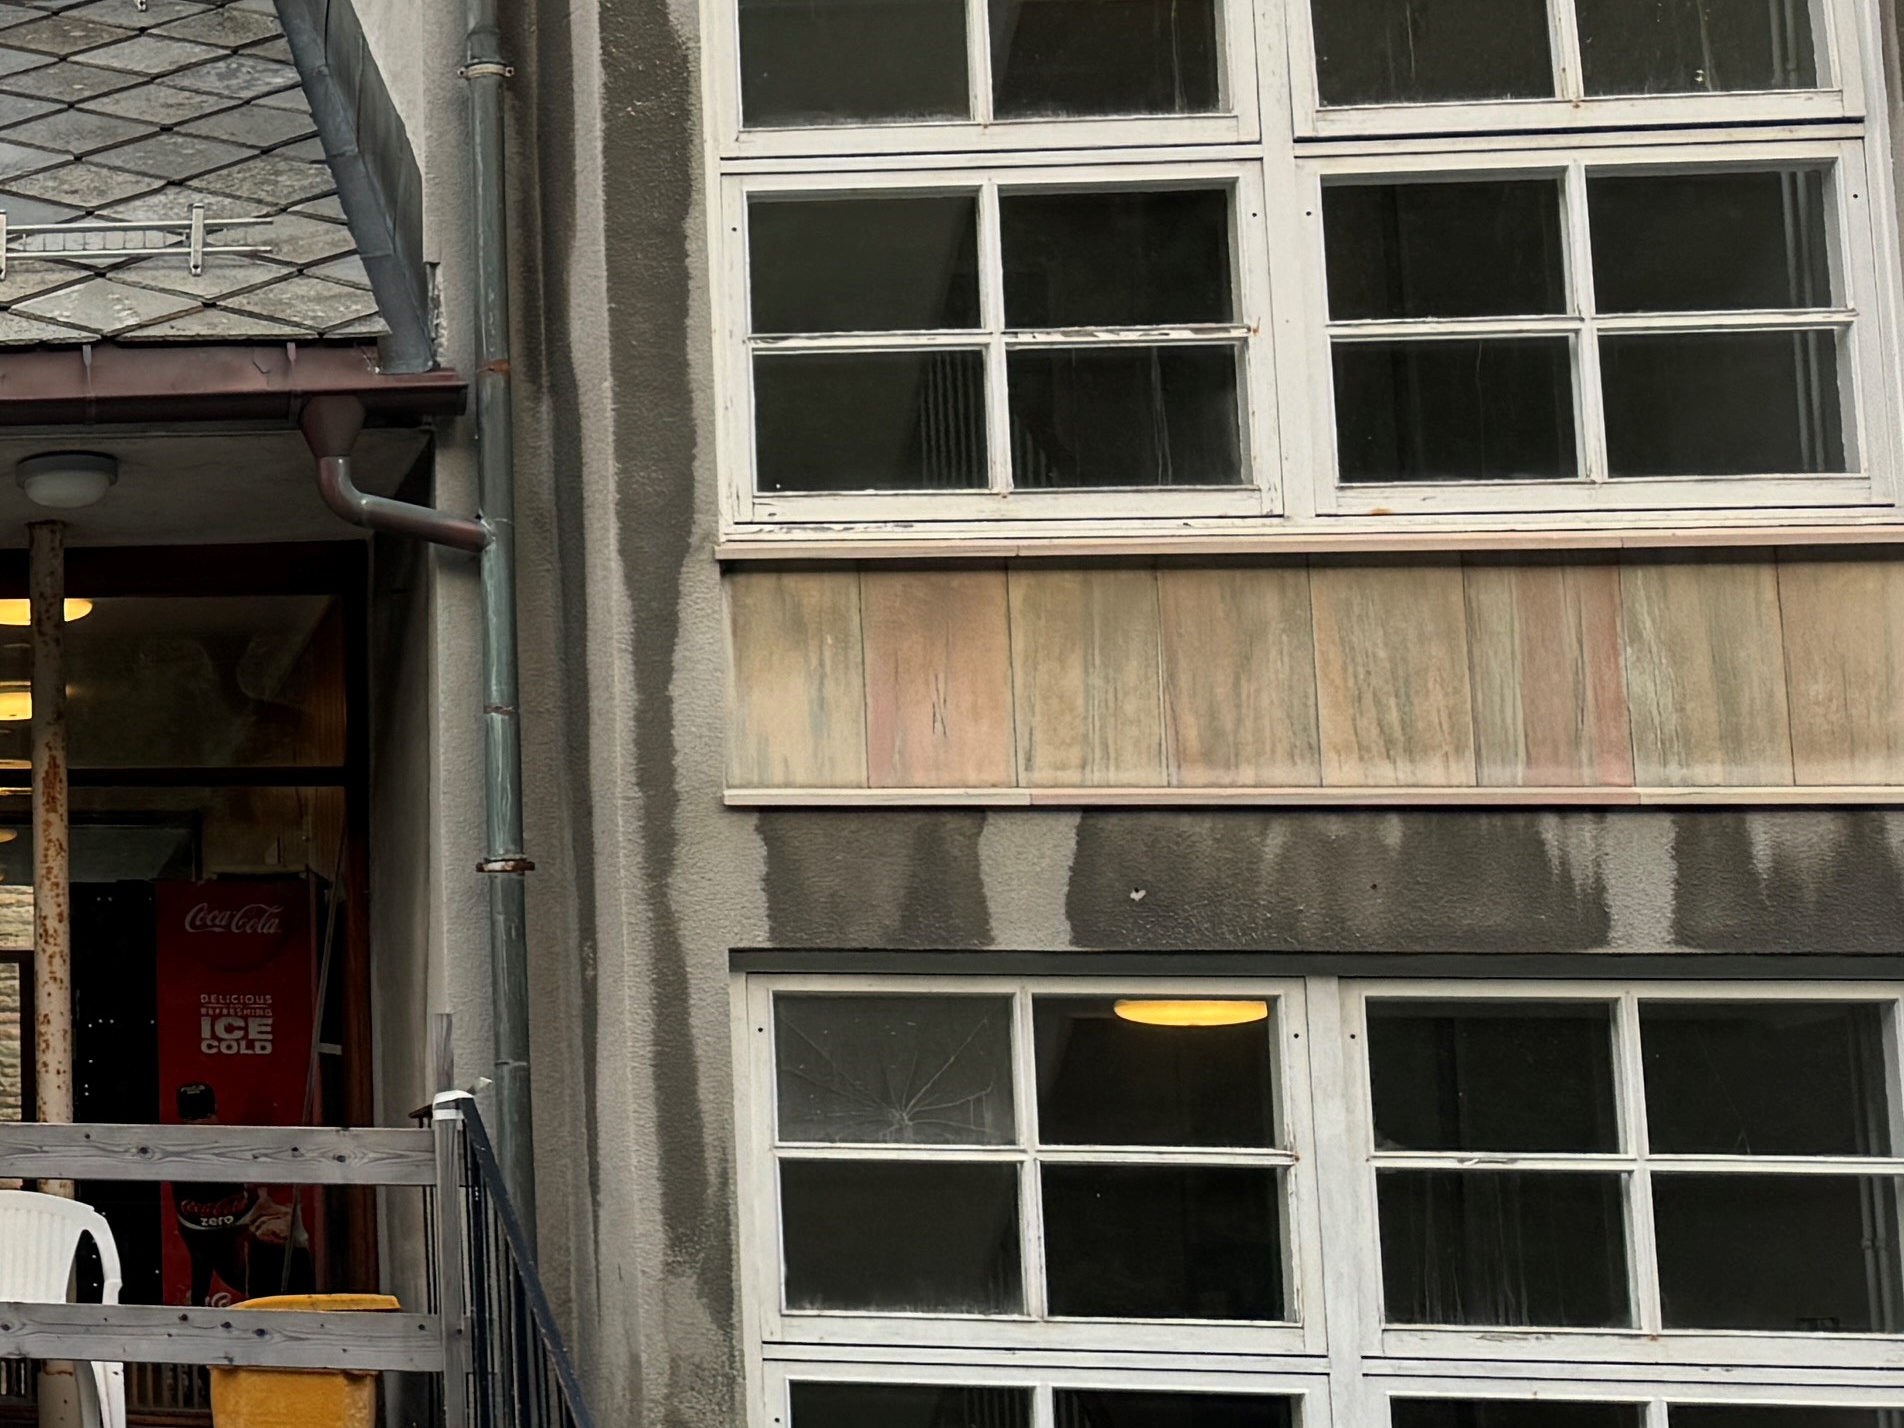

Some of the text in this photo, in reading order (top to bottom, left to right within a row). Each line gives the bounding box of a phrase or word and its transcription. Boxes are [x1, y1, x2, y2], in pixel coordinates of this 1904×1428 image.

[200, 994, 273, 1004] DELICIOUS
[200, 1016, 273, 1040] ICE
[200, 1039, 273, 1054] COLD
[200, 1215, 235, 1227] zero
